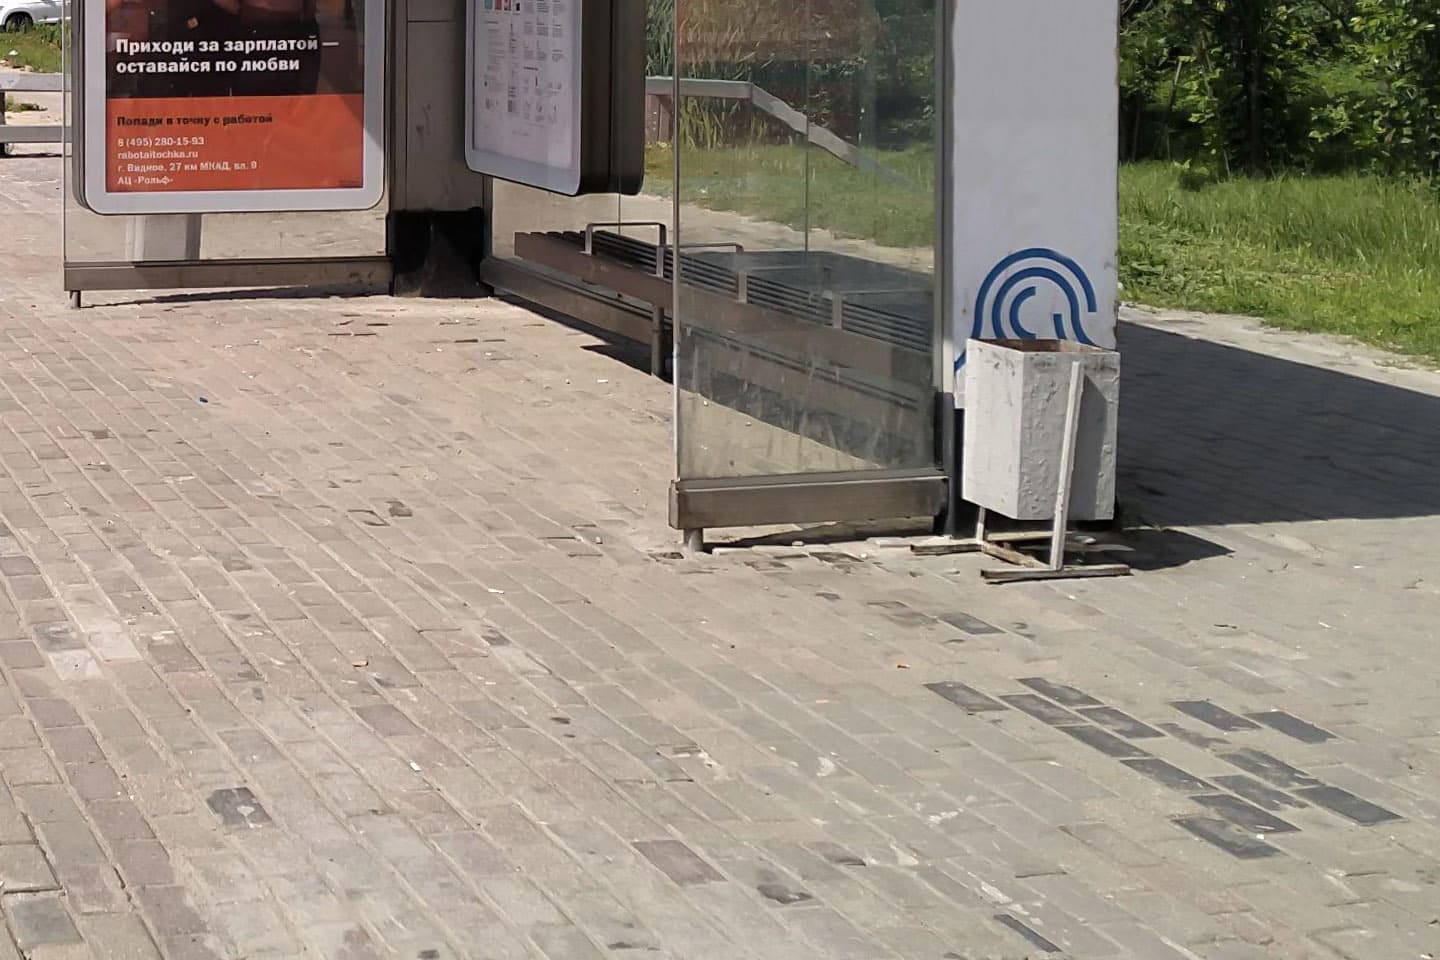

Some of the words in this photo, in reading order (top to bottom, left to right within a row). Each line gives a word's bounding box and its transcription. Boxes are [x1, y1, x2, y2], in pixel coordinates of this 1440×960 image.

[116, 39, 194, 56] Приходи
[198, 41, 220, 52] за
[223, 35, 318, 54] зарплатой
[116, 57, 211, 73] оставайся
[215, 60, 237, 72] по
[240, 57, 300, 72] любви
[117, 116, 163, 126] Попади
[166, 117, 174, 125] в
[176, 117, 210, 127] точку
[213, 117, 220, 125] с
[222, 113, 273, 126] работой
[125, 137, 153, 148] (495)
[154, 136, 205, 146] 280-15-93
[118, 150, 199, 160] rabotaitochka.ru
[169, 162, 182, 172] 27
